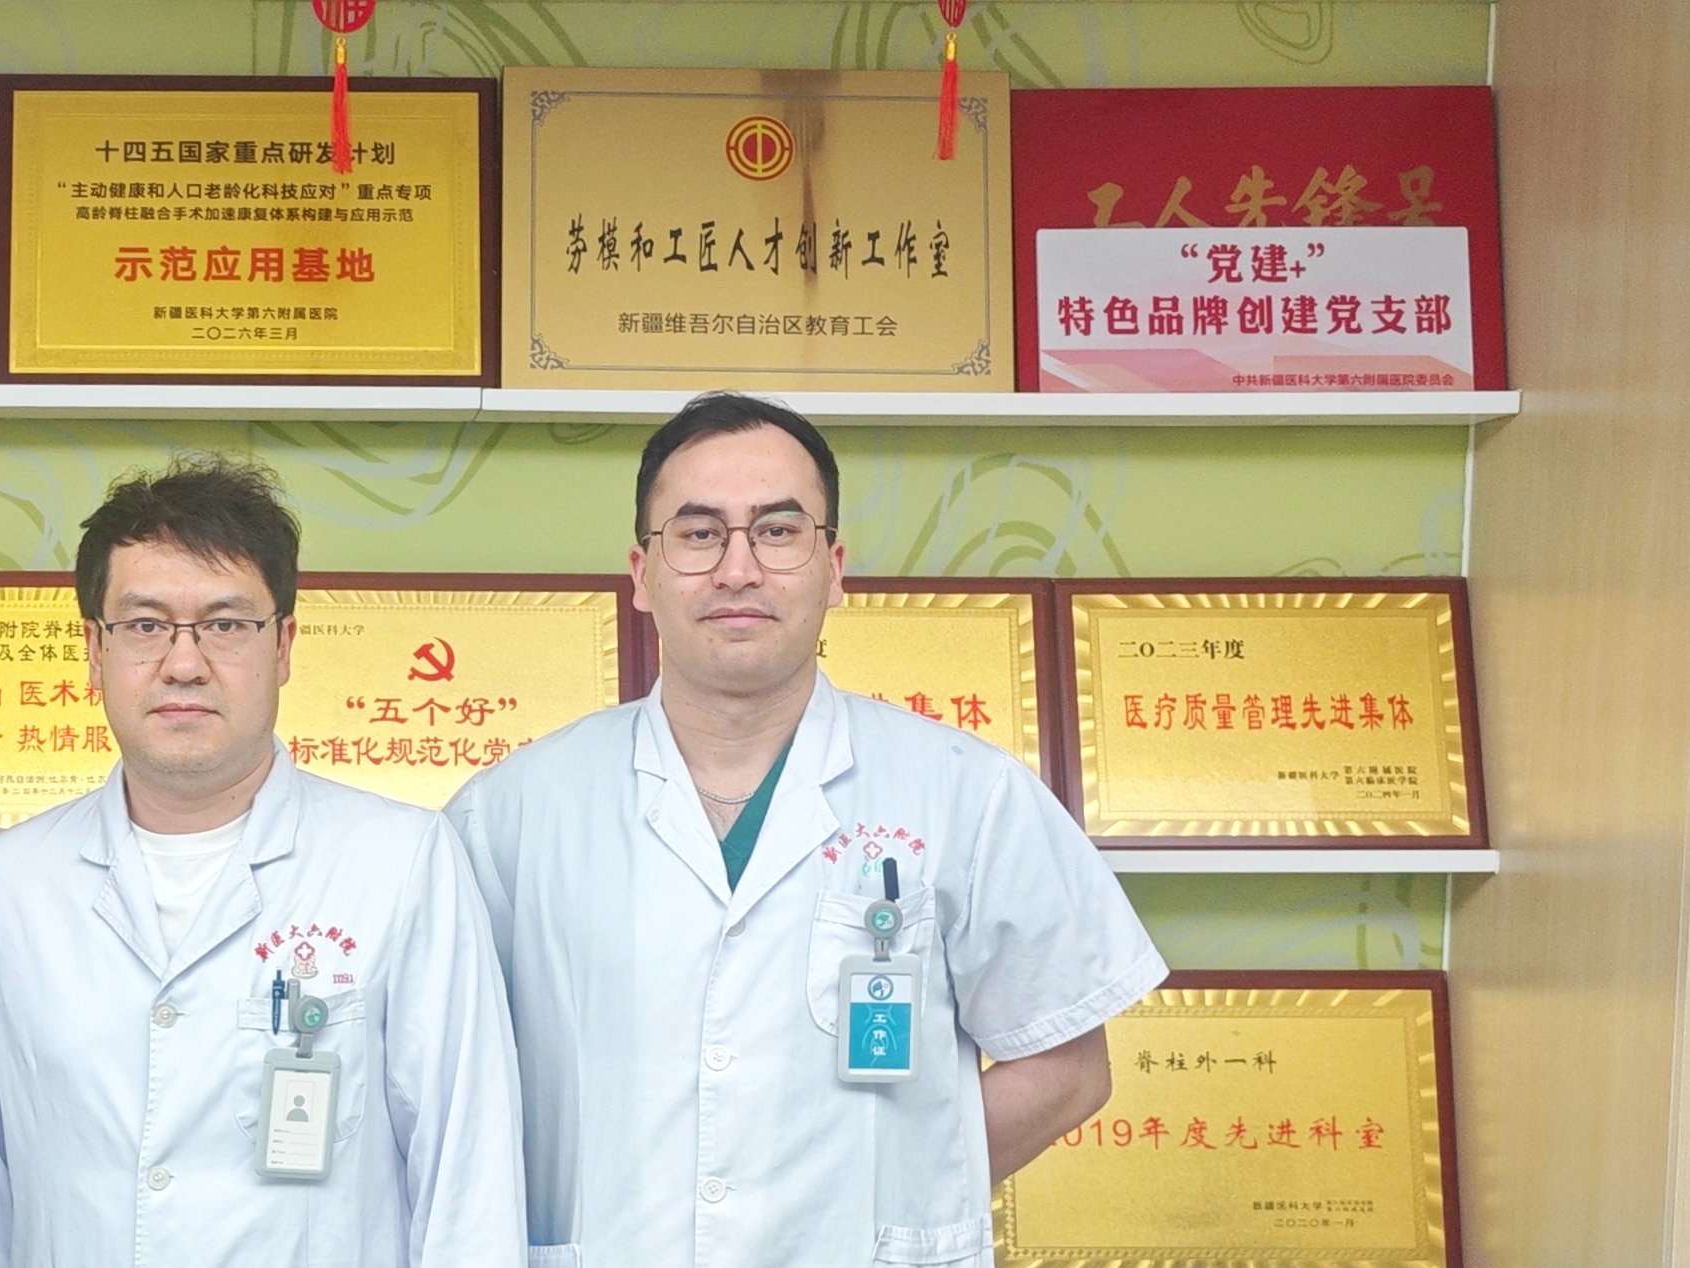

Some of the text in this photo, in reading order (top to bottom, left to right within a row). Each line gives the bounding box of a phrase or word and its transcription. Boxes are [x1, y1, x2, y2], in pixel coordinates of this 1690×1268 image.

[75, 206, 414, 222] 高龄脊柱融合手术加速康复体系构建与应用示范
[566, 213, 951, 280] 劳模和工匠人才创新工作室
[114, 246, 375, 283] 示范应用基地
[153, 306, 338, 320] 新疆医科大学第六附属医院
[618, 312, 898, 338] 新疆维吾尔自治区教育工会
[1057, 294, 1452, 337] 特色品牌创建党支部
[1232, 373, 1455, 387] 中共新疆医科大学第六附属医院委员会
[346, 697, 517, 726] “五个好”
[871, 691, 991, 731] 集体
[1123, 692, 1415, 731] 医疗质量管理先进集体
[18, 724, 112, 753] 热情服
[289, 736, 533, 767] 标准化规范化党
[872, 1013, 887, 1057] 工作证
[1134, 1050, 1277, 1074] 脊柱外一科
[1050, 1114, 1385, 1151] 019年度先进科室
